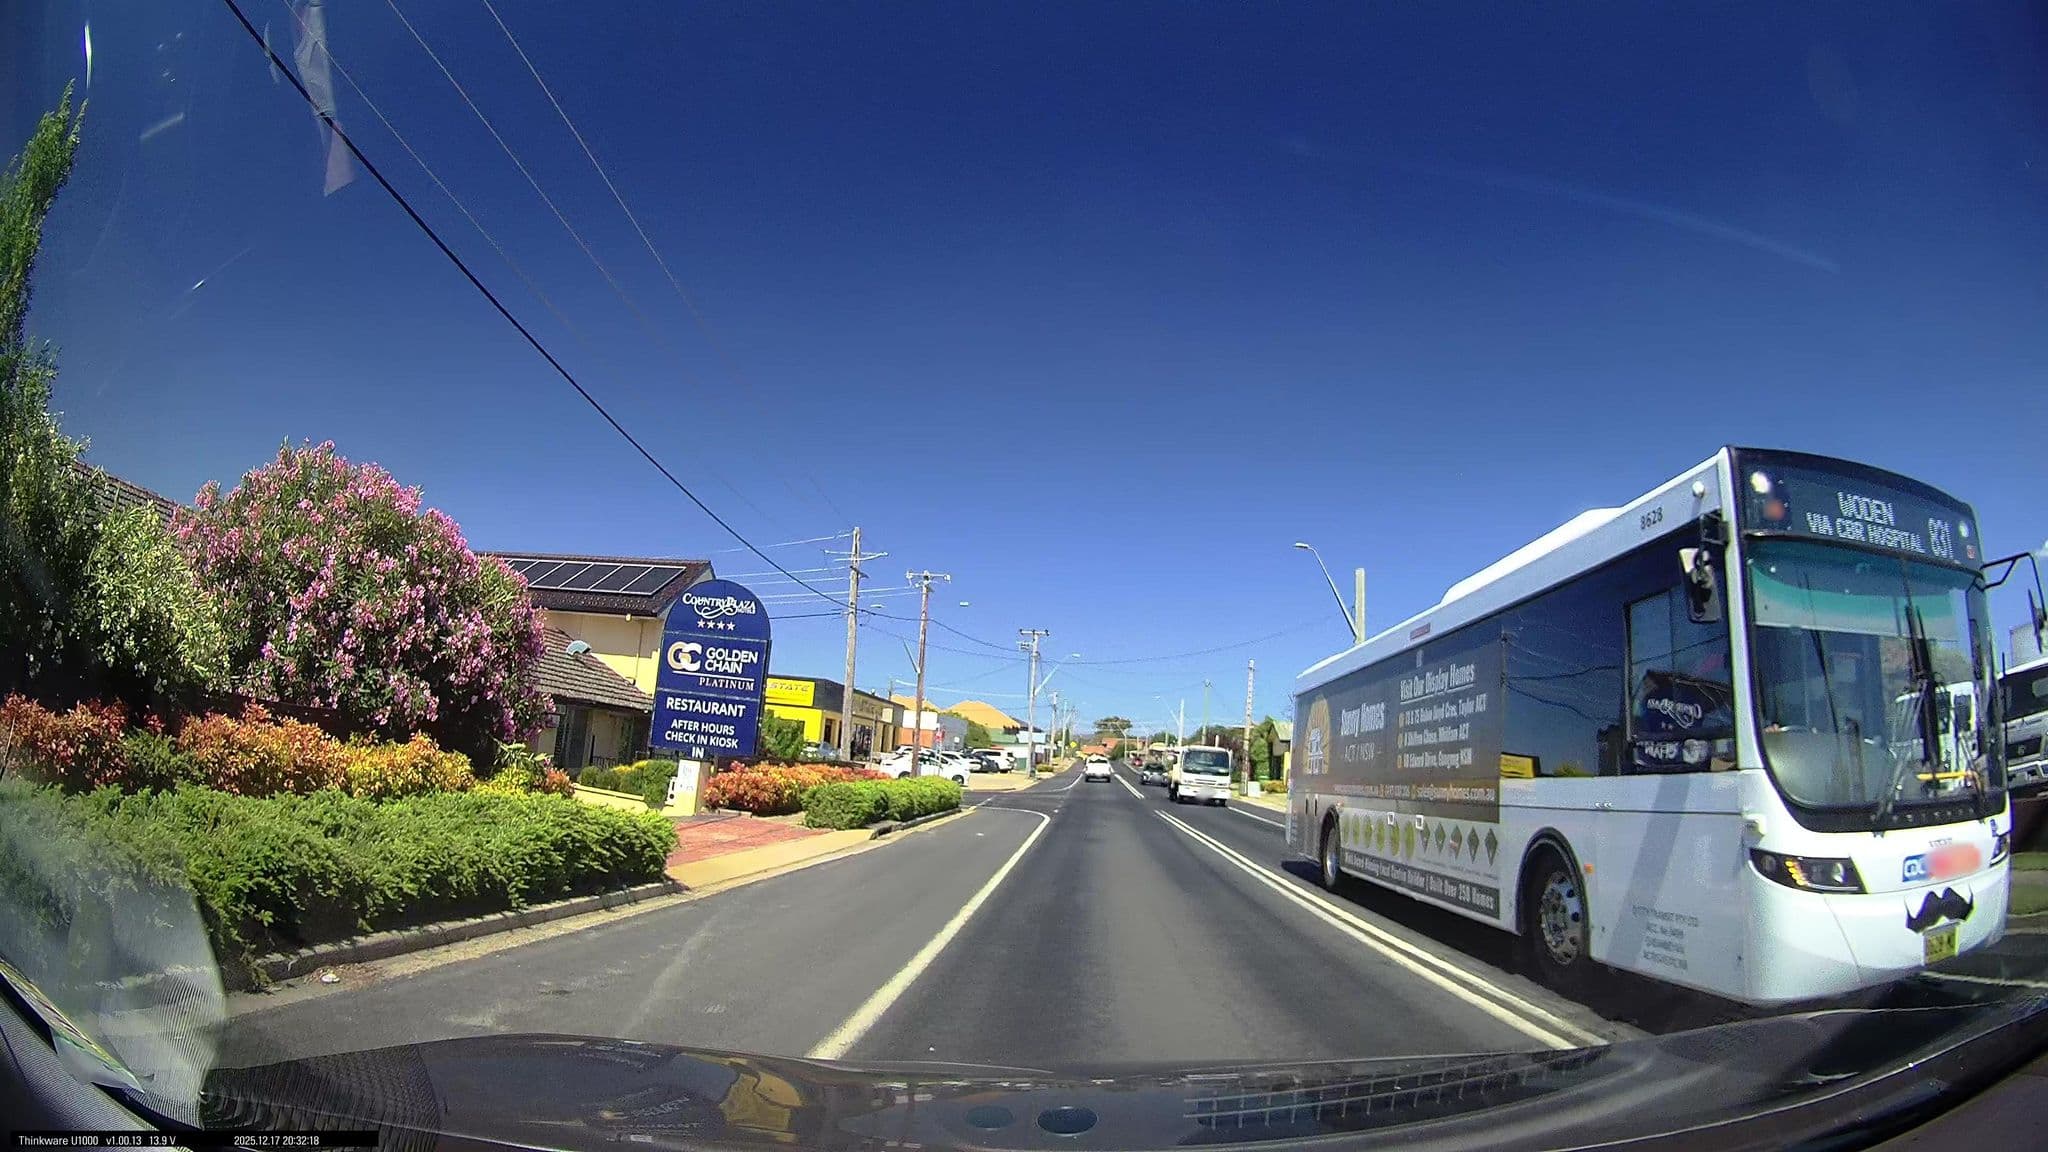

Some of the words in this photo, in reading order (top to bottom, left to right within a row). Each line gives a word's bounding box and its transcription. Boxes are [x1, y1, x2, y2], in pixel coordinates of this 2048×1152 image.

[1837, 491, 1895, 526] WODEN
[1806, 512, 1833, 536] VIA
[1867, 522, 1926, 553] HOSPITAL
[706, 646, 759, 664] GOLDEN
[704, 659, 743, 674] CHAIN
[1450, 663, 1475, 687] Homes
[699, 677, 755, 691] PLATINUM
[769, 681, 811, 692] STATE
[666, 696, 746, 718] RESTAURANT
[671, 718, 699, 732] AFTER
[701, 721, 735, 736] HOURS
[665, 730, 696, 744] CHECK
[697, 734, 708, 746] IN
[709, 735, 739, 749] KIOSK
[691, 747, 705, 759] IN
